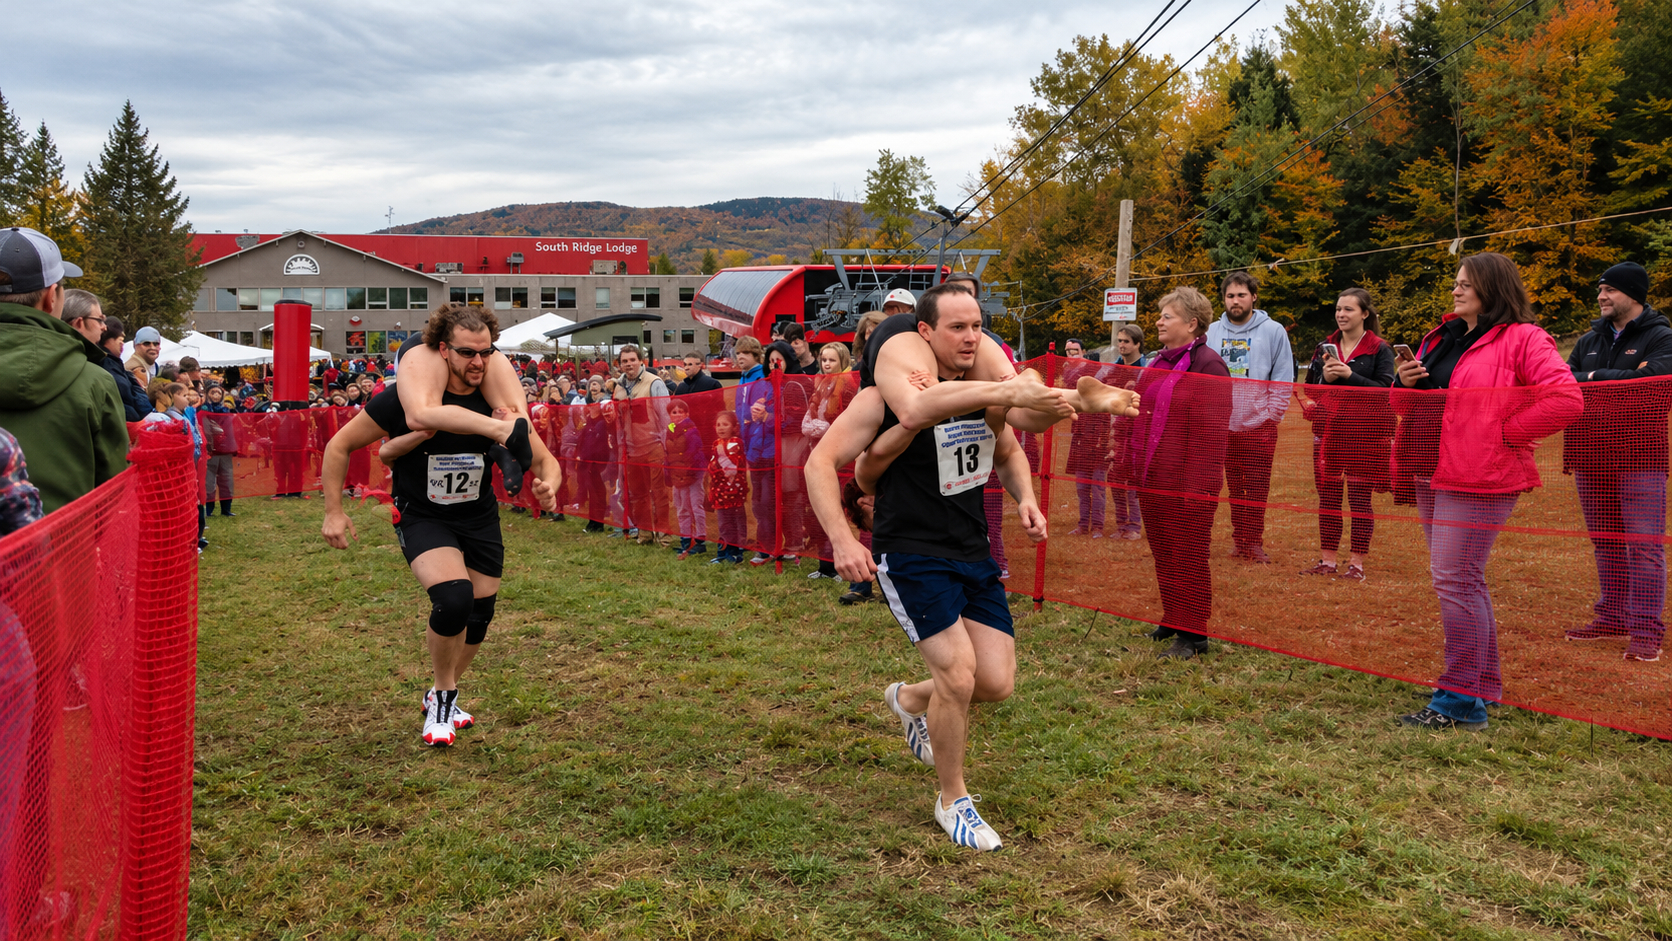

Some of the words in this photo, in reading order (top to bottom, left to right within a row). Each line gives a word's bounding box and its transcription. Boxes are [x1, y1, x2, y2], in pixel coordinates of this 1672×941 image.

[535, 241, 569, 252] South
[572, 242, 602, 255] Ridge
[606, 242, 638, 255] Lodge
[953, 443, 980, 477] 13
[443, 471, 470, 495] 12
